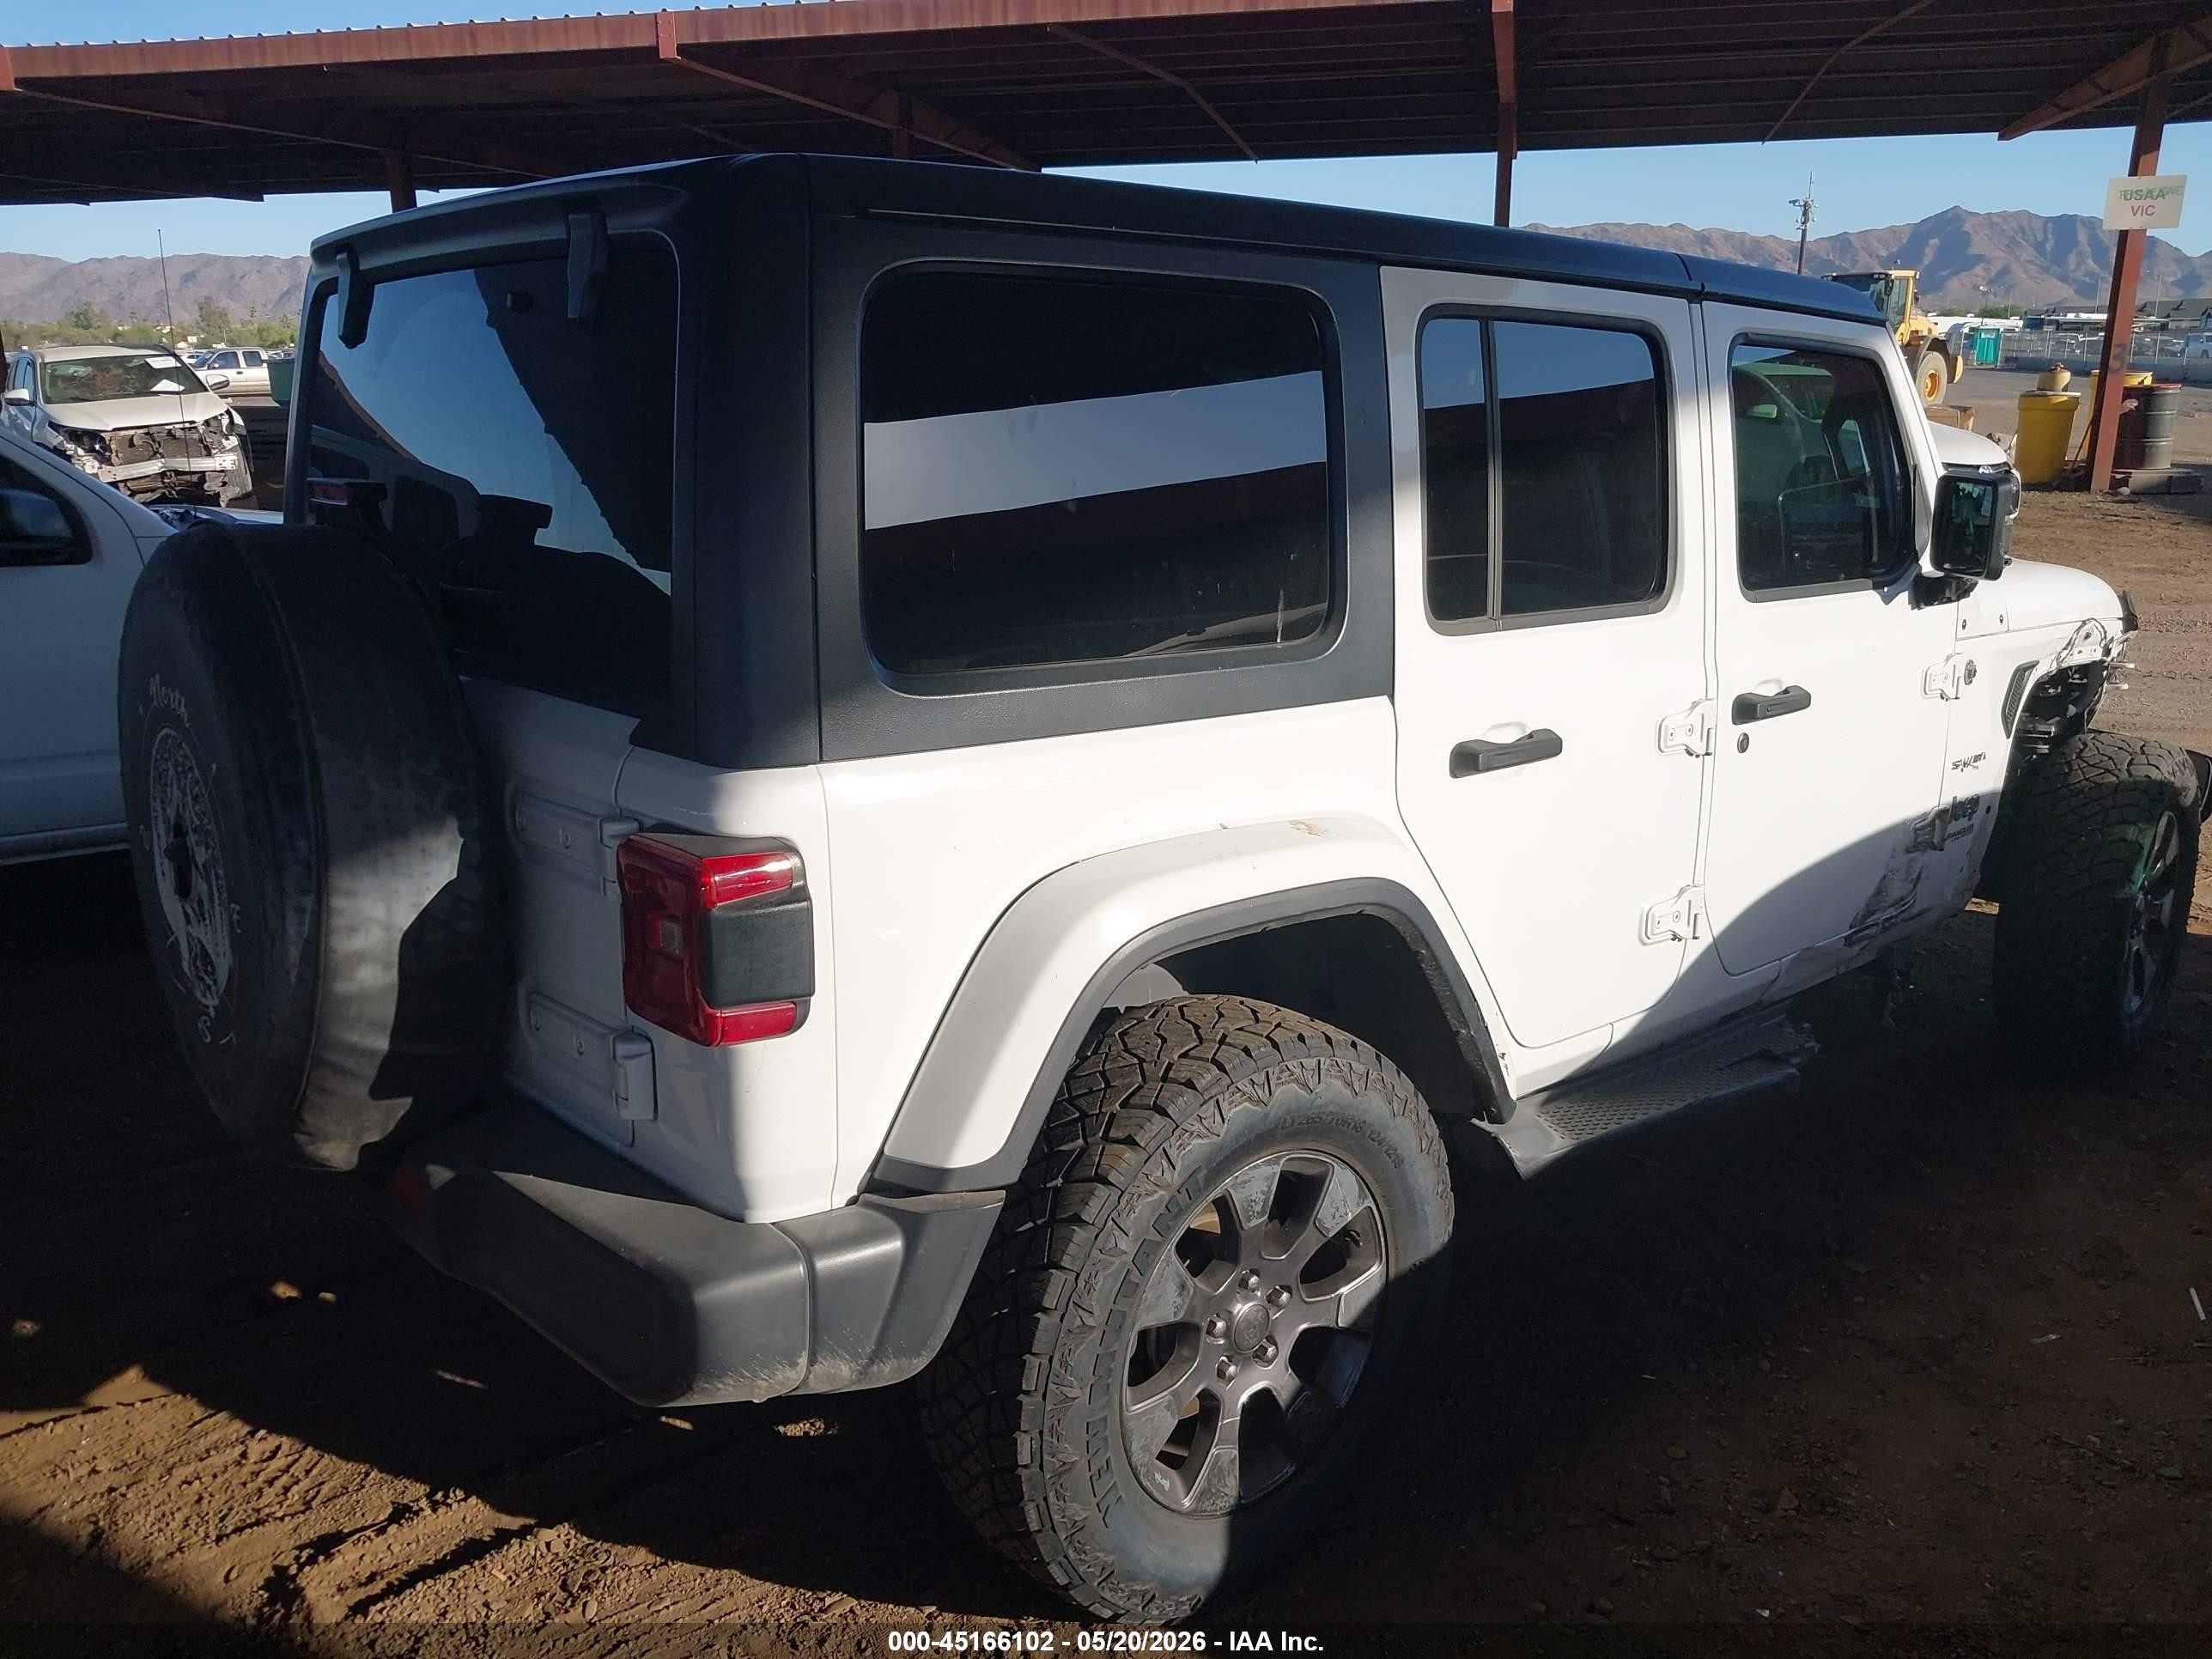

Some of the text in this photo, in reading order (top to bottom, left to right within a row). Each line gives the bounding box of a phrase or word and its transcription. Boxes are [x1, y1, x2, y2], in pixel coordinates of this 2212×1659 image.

[2122, 188, 2166, 202] USAA
[2130, 204, 2156, 217] VIC
[1085, 1413, 1121, 1529] NEW
